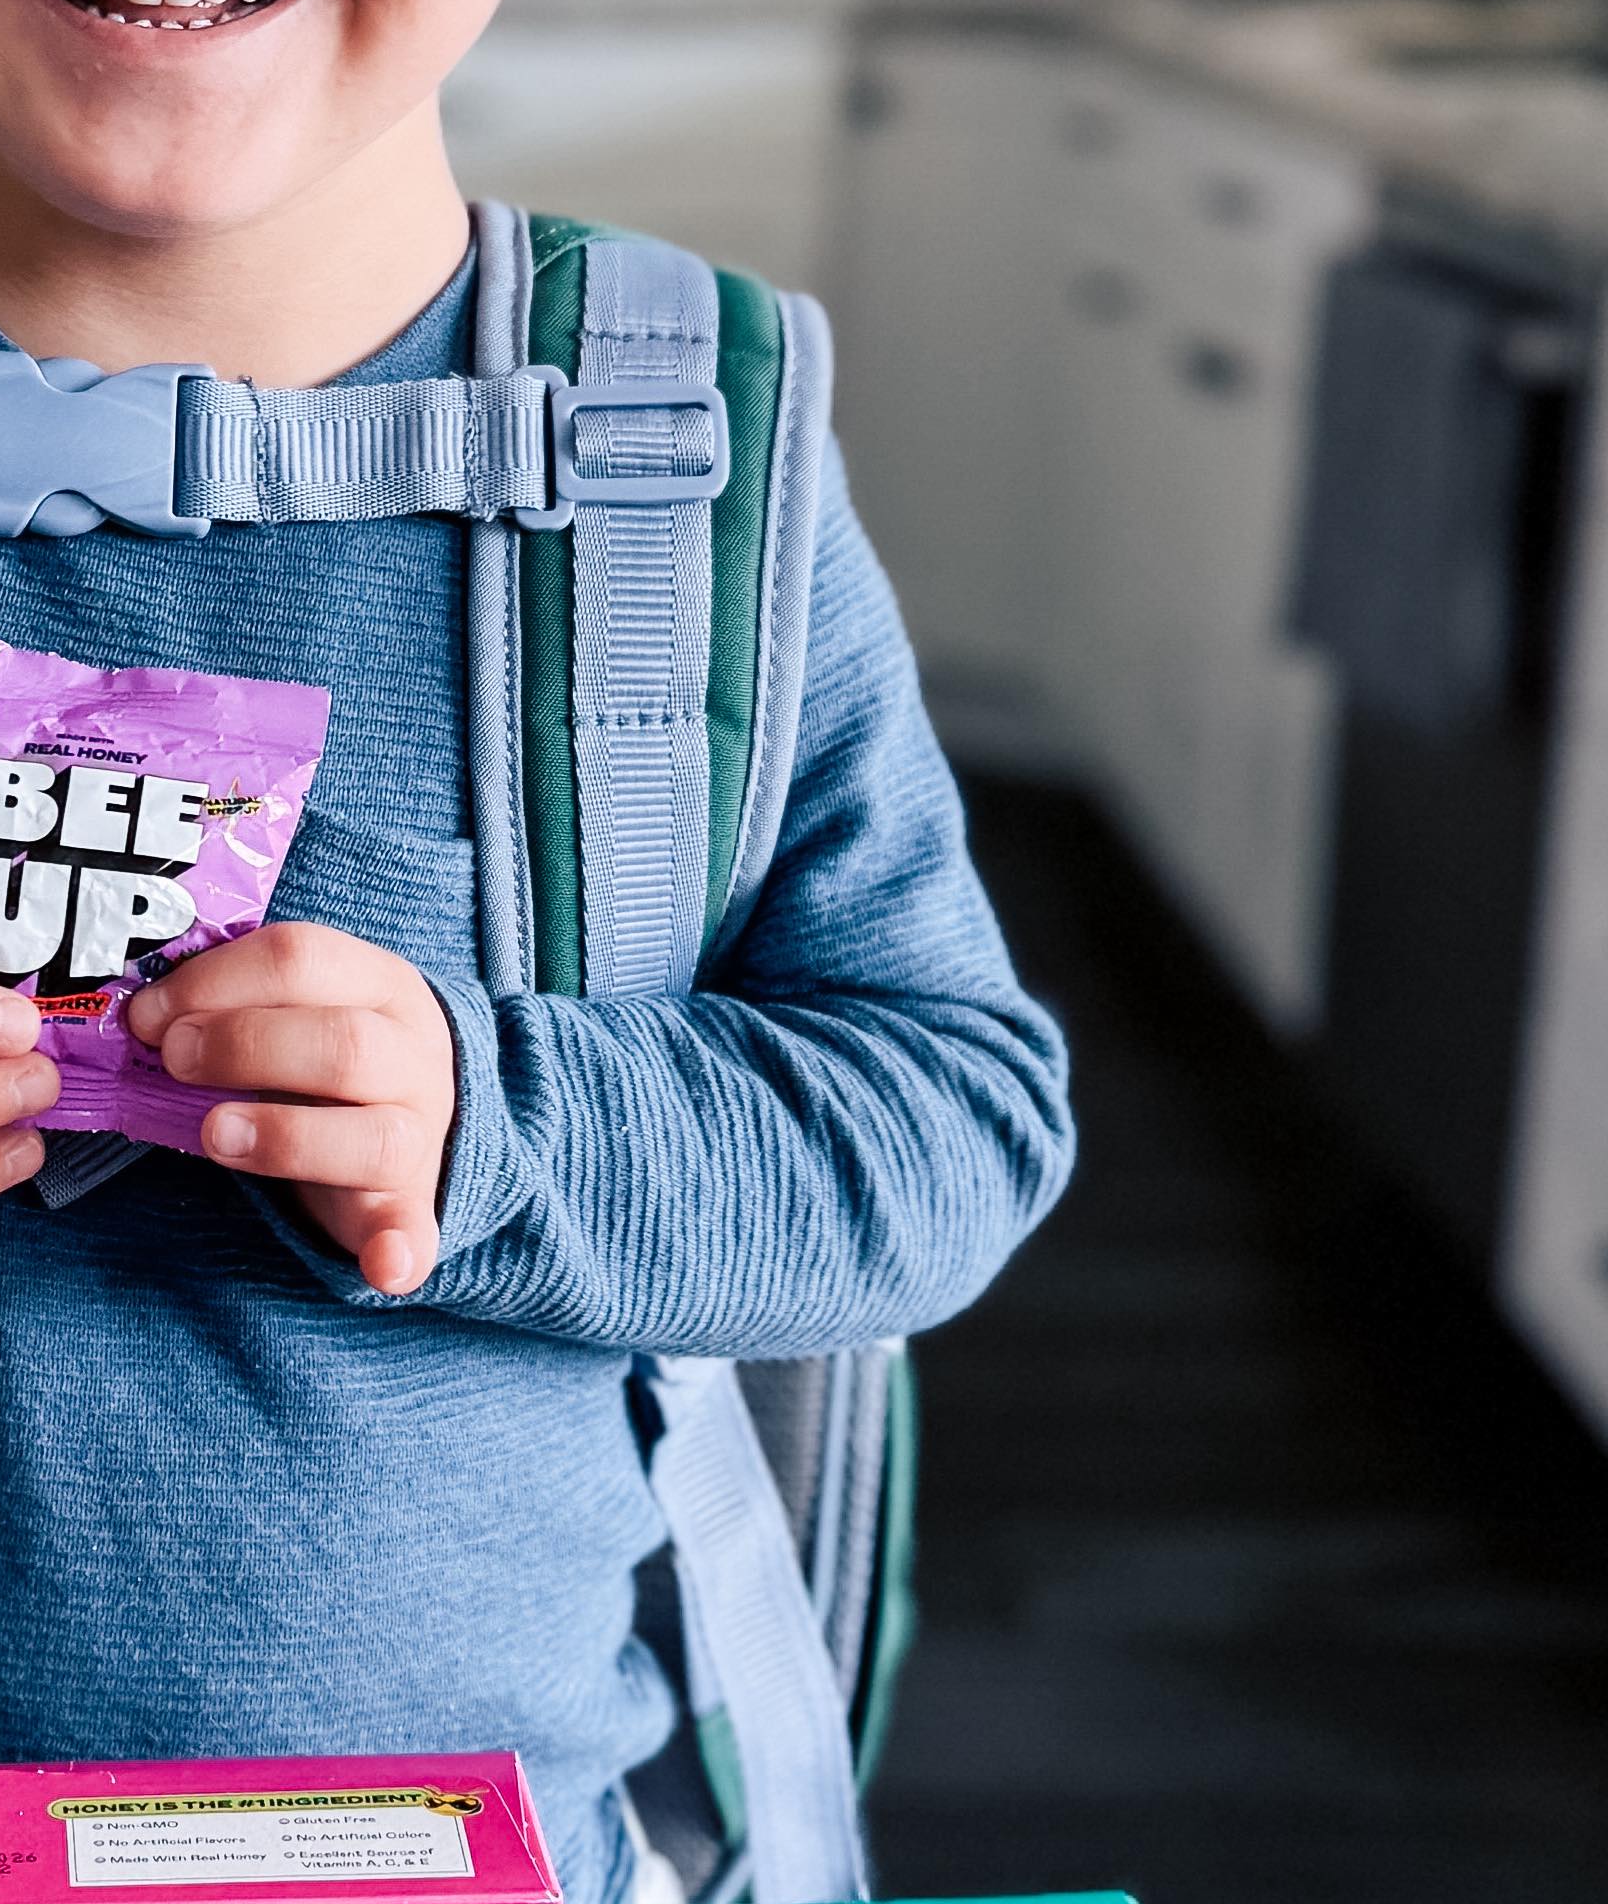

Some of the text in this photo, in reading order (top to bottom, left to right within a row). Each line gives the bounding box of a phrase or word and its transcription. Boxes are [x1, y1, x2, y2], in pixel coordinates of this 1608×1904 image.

[24, 742, 148, 765] REAL HONEY
[62, 1802, 149, 1814] HONEY
[155, 1801, 178, 1811] IS
[182, 1800, 233, 1810] THE
[269, 1794, 422, 1807] INGREDIENT
[293, 1815, 376, 1824] Gluten Free
[107, 1820, 178, 1830] Non-GMO
[109, 1836, 246, 1847] No Artificial Flavors
[296, 1834, 316, 1842] No
[320, 1832, 382, 1841] Artificial
[419, 1847, 435, 1856] of
[110, 1853, 267, 1864] Made With Real Honey
[301, 1860, 362, 1869] Vitamins
